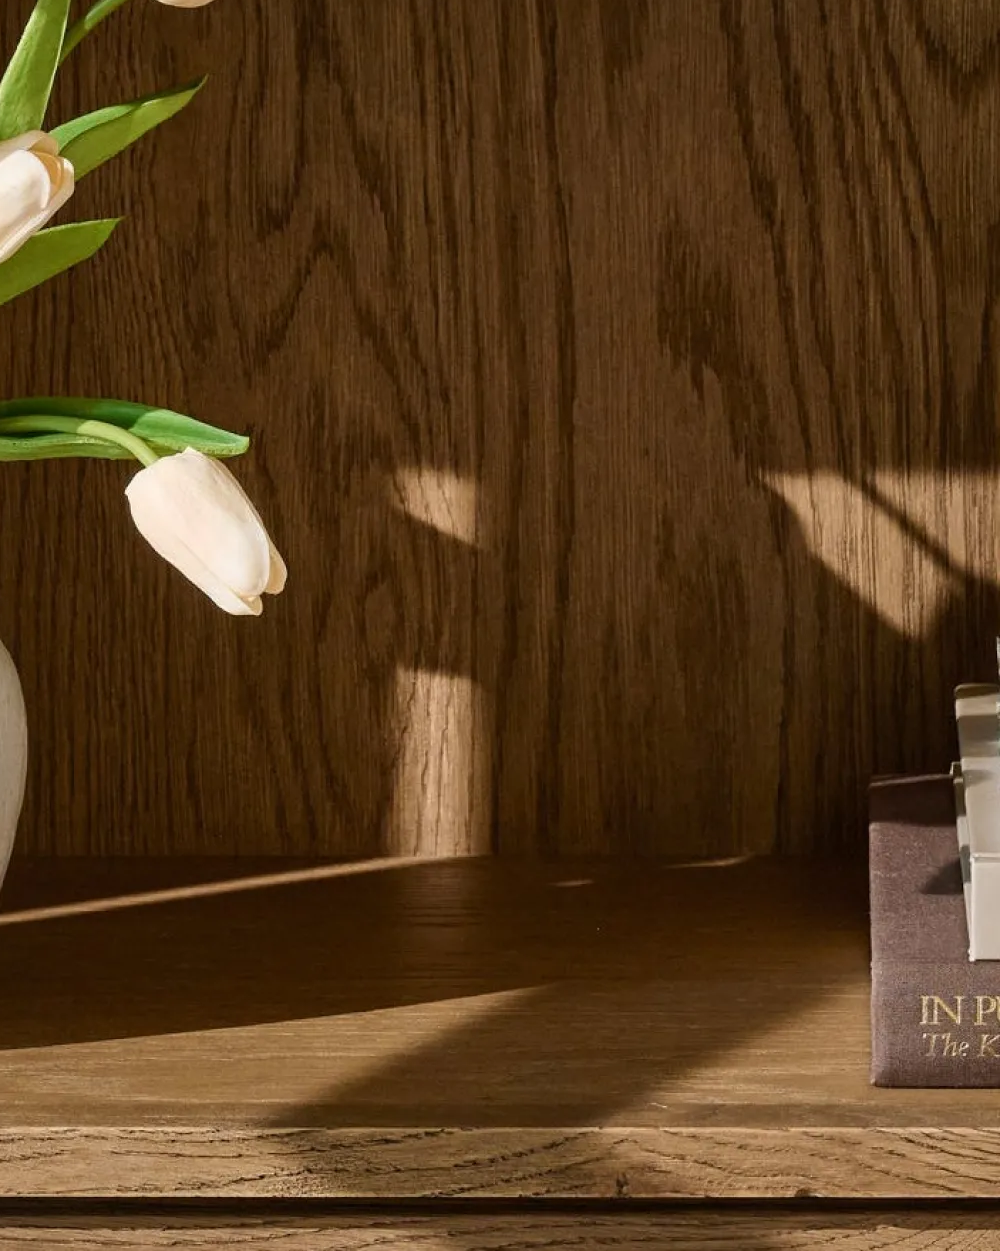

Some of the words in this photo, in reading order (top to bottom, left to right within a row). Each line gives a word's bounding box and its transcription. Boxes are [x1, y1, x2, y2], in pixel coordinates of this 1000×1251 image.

[920, 995, 965, 1025] IN
[974, 995, 1000, 1025] P
[923, 1032, 969, 1057] The
